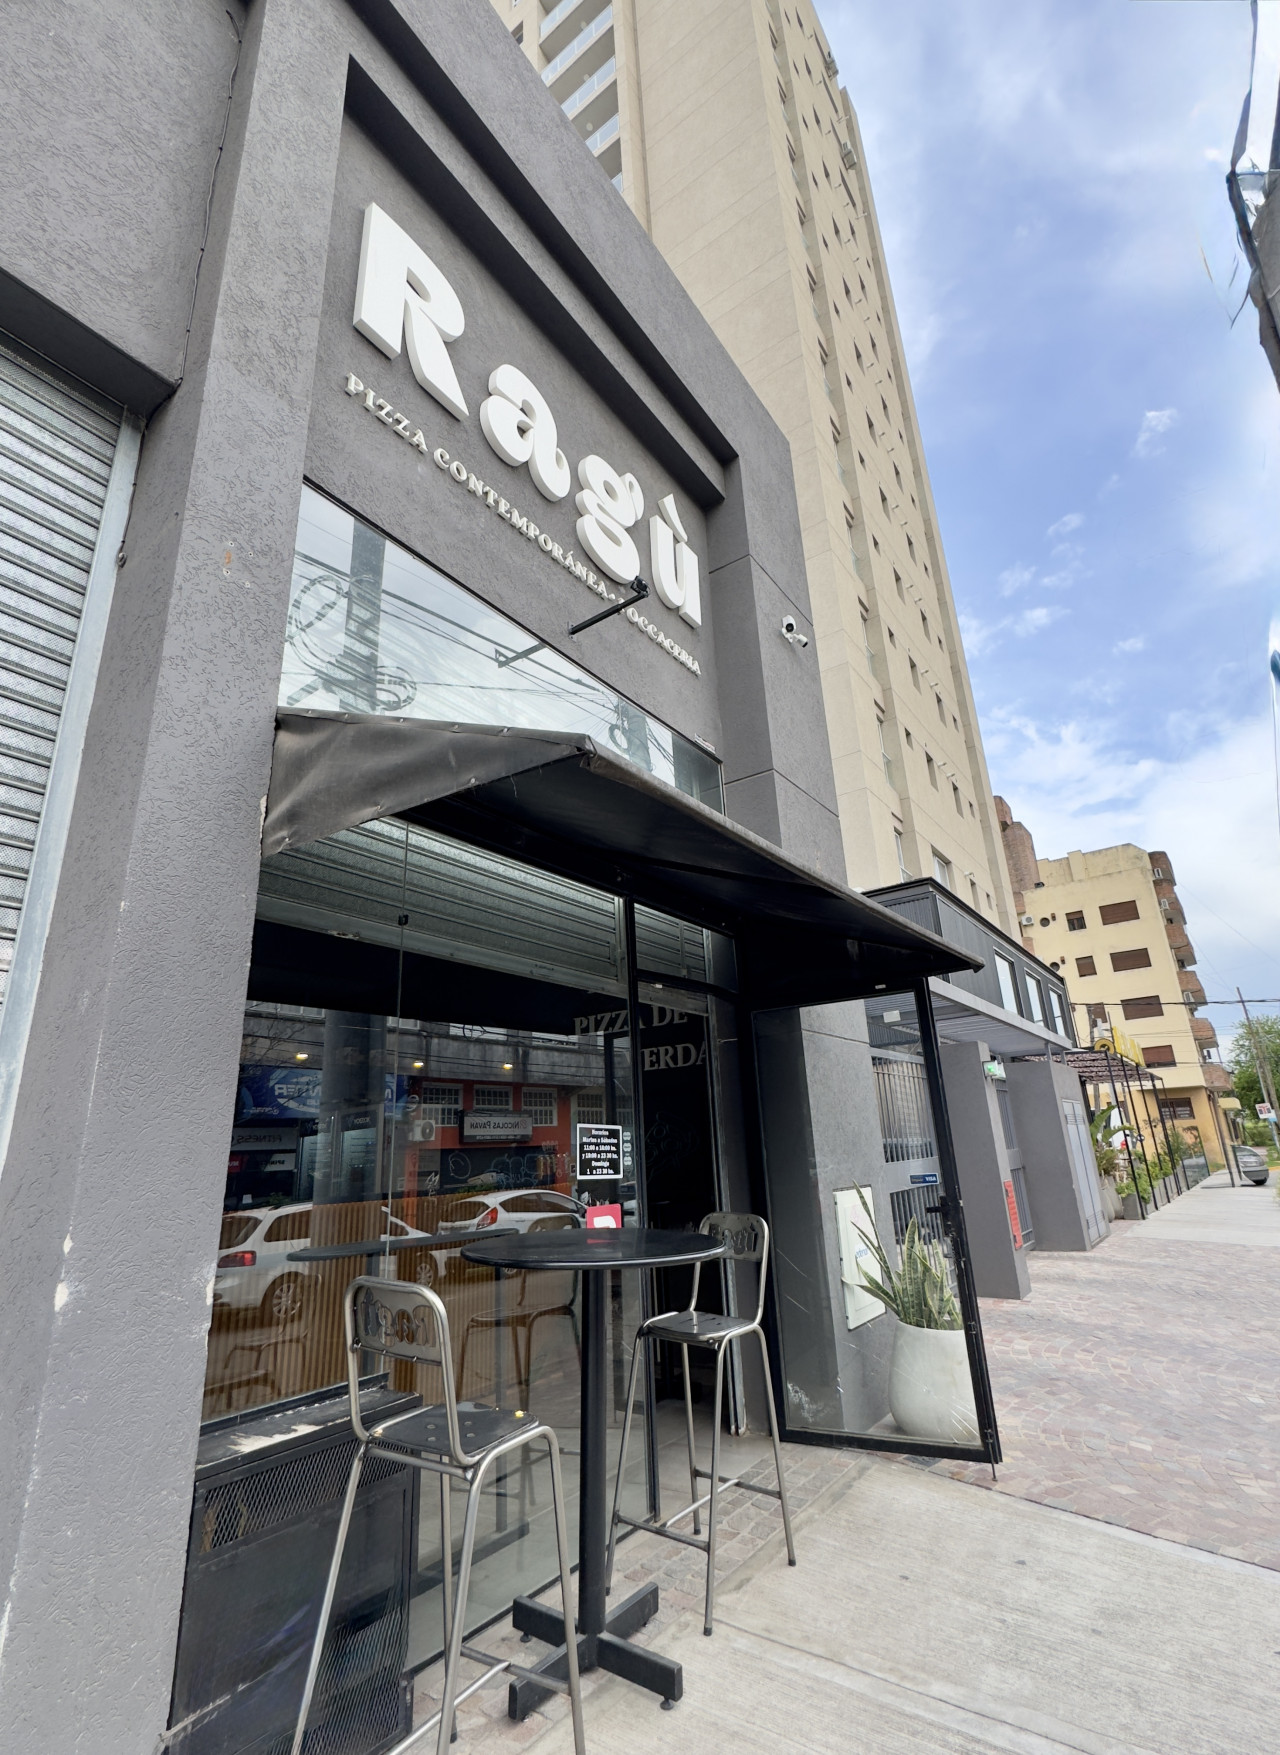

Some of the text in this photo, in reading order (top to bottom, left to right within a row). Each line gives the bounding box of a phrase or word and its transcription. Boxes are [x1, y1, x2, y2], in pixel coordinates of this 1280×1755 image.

[345, 372, 428, 455] PIZZA
[433, 447, 609, 600] CONTEMPORÁNEA
[353, 201, 702, 630] Ragú
[651, 1005, 689, 1028] DE
